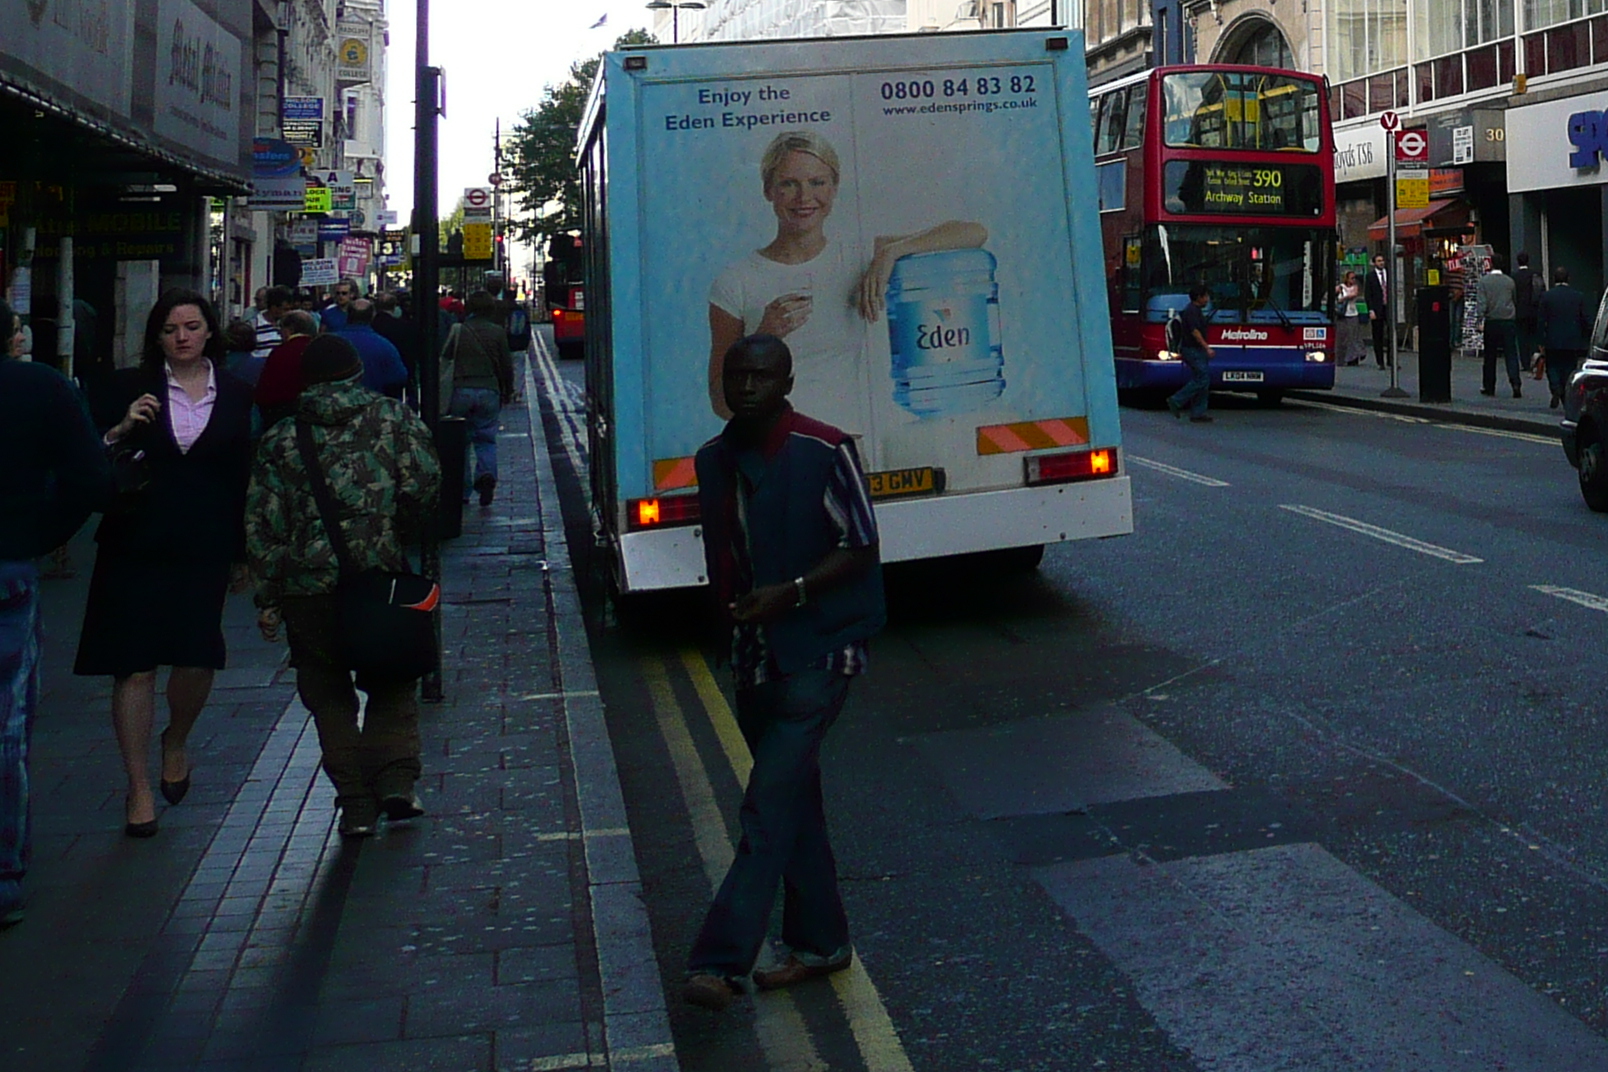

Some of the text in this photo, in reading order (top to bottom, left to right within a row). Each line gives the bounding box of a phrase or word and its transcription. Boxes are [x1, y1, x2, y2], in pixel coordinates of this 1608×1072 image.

[699, 86, 790, 107] Enjoy the
[881, 75, 1036, 99] 0800 84 83 82
[883, 97, 1038, 116] www.edensprings.co.uk
[666, 109, 831, 131] Eden Experience
[1385, 114, 1395, 127] V
[1485, 128, 1504, 141] 30
[1334, 141, 1373, 175] oyds TSB
[1253, 169, 1282, 188] 390
[1205, 190, 1281, 206] Archway Station
[917, 324, 970, 350] Eden
[1221, 328, 1268, 342] Metroline
[889, 470, 924, 490] GMV
